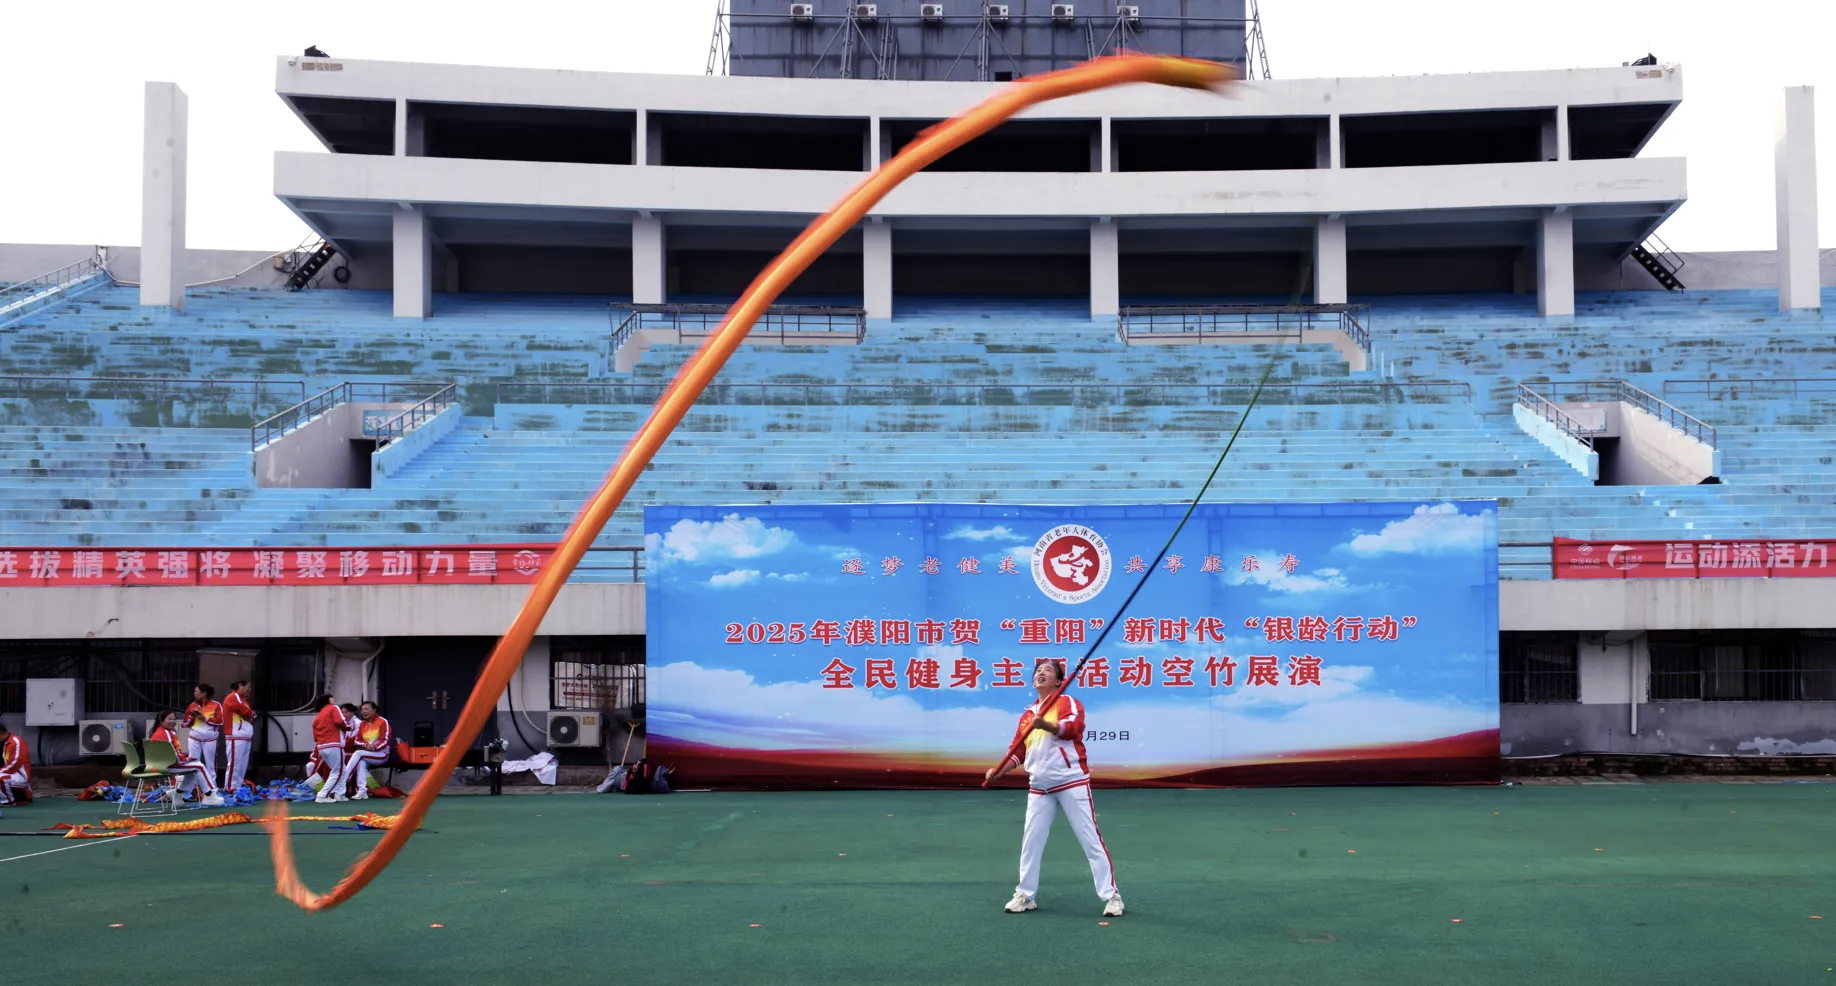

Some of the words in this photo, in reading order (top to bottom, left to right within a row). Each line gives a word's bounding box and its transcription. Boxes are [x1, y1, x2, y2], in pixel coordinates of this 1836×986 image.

[1033, 526, 1109, 557] 河南省老年人体育协会
[1664, 542, 1828, 569] 运动添活力
[0, 551, 231, 579] 选拔精英强将
[253, 550, 498, 578] 凝聚移动力量
[841, 555, 1020, 576] 逐梦老健美
[1124, 553, 1300, 574] 共享康乐寿
[1069, 592, 1093, 602] Sports
[1091, 559, 1110, 595] Association
[821, 655, 1323, 689] 全民健身主活动空竹展演
